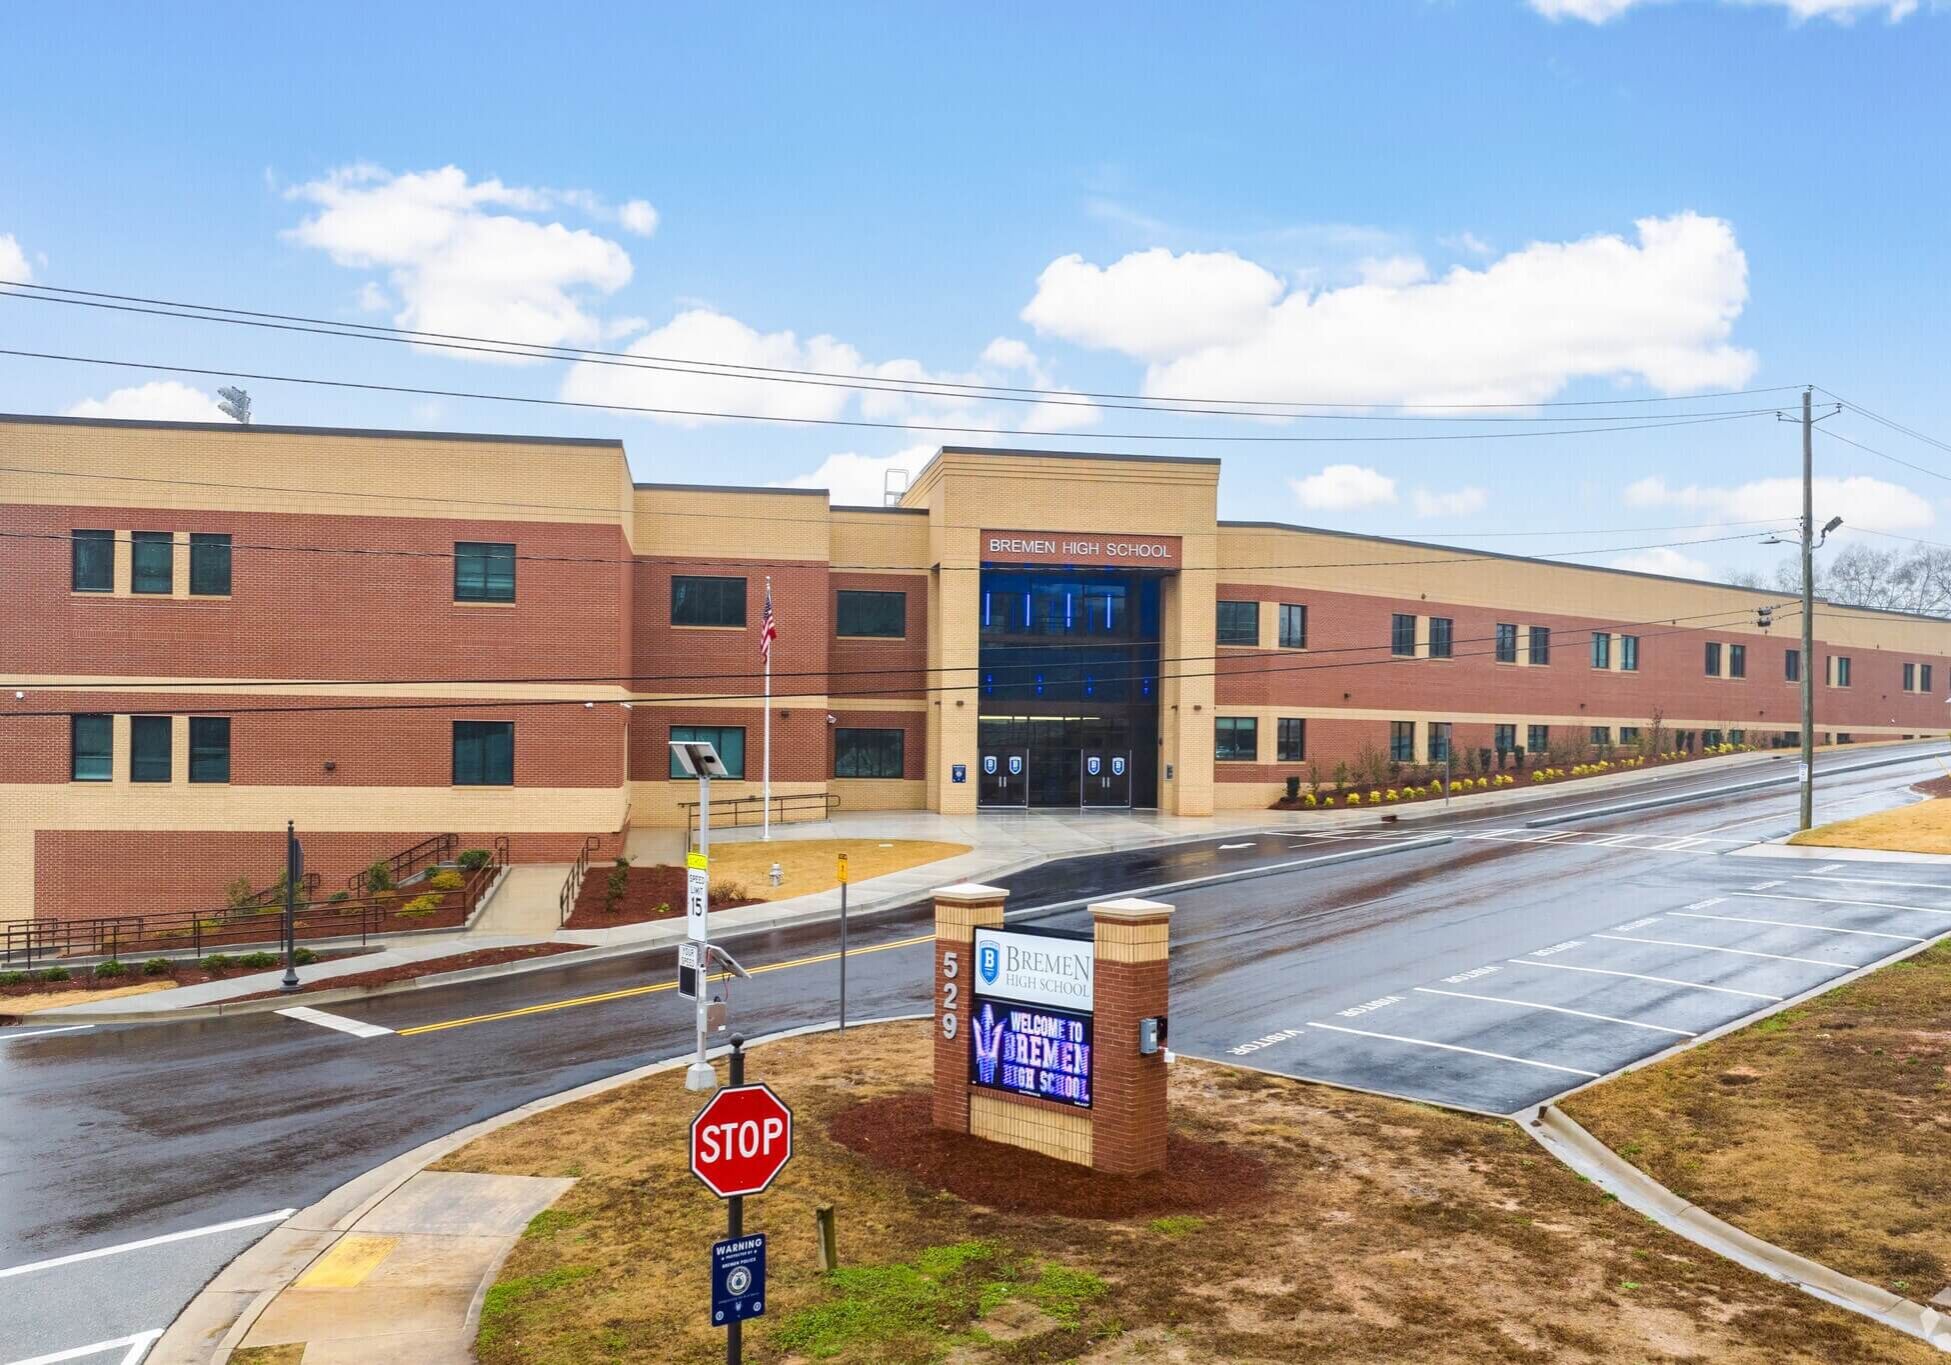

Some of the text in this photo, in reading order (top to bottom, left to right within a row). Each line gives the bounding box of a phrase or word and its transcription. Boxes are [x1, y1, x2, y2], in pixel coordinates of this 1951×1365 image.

[989, 539, 1172, 558] BREMEN HIGH SCHOOL
[691, 897, 703, 917] 15
[1006, 945, 1091, 981] BREMEN
[943, 952, 958, 1040] 529
[1006, 973, 1090, 998] HIGH SCHOOL
[1335, 995, 1406, 1017] VISITOR
[1010, 1011, 1083, 1043] WELCOME TO
[1003, 1031, 1090, 1077] BREMEN
[1225, 1029, 1304, 1055] VISITOR
[1003, 1064, 1090, 1102] HIGH SCHOOL
[701, 1117, 783, 1164] STOP
[716, 1238, 762, 1256] WARNING
